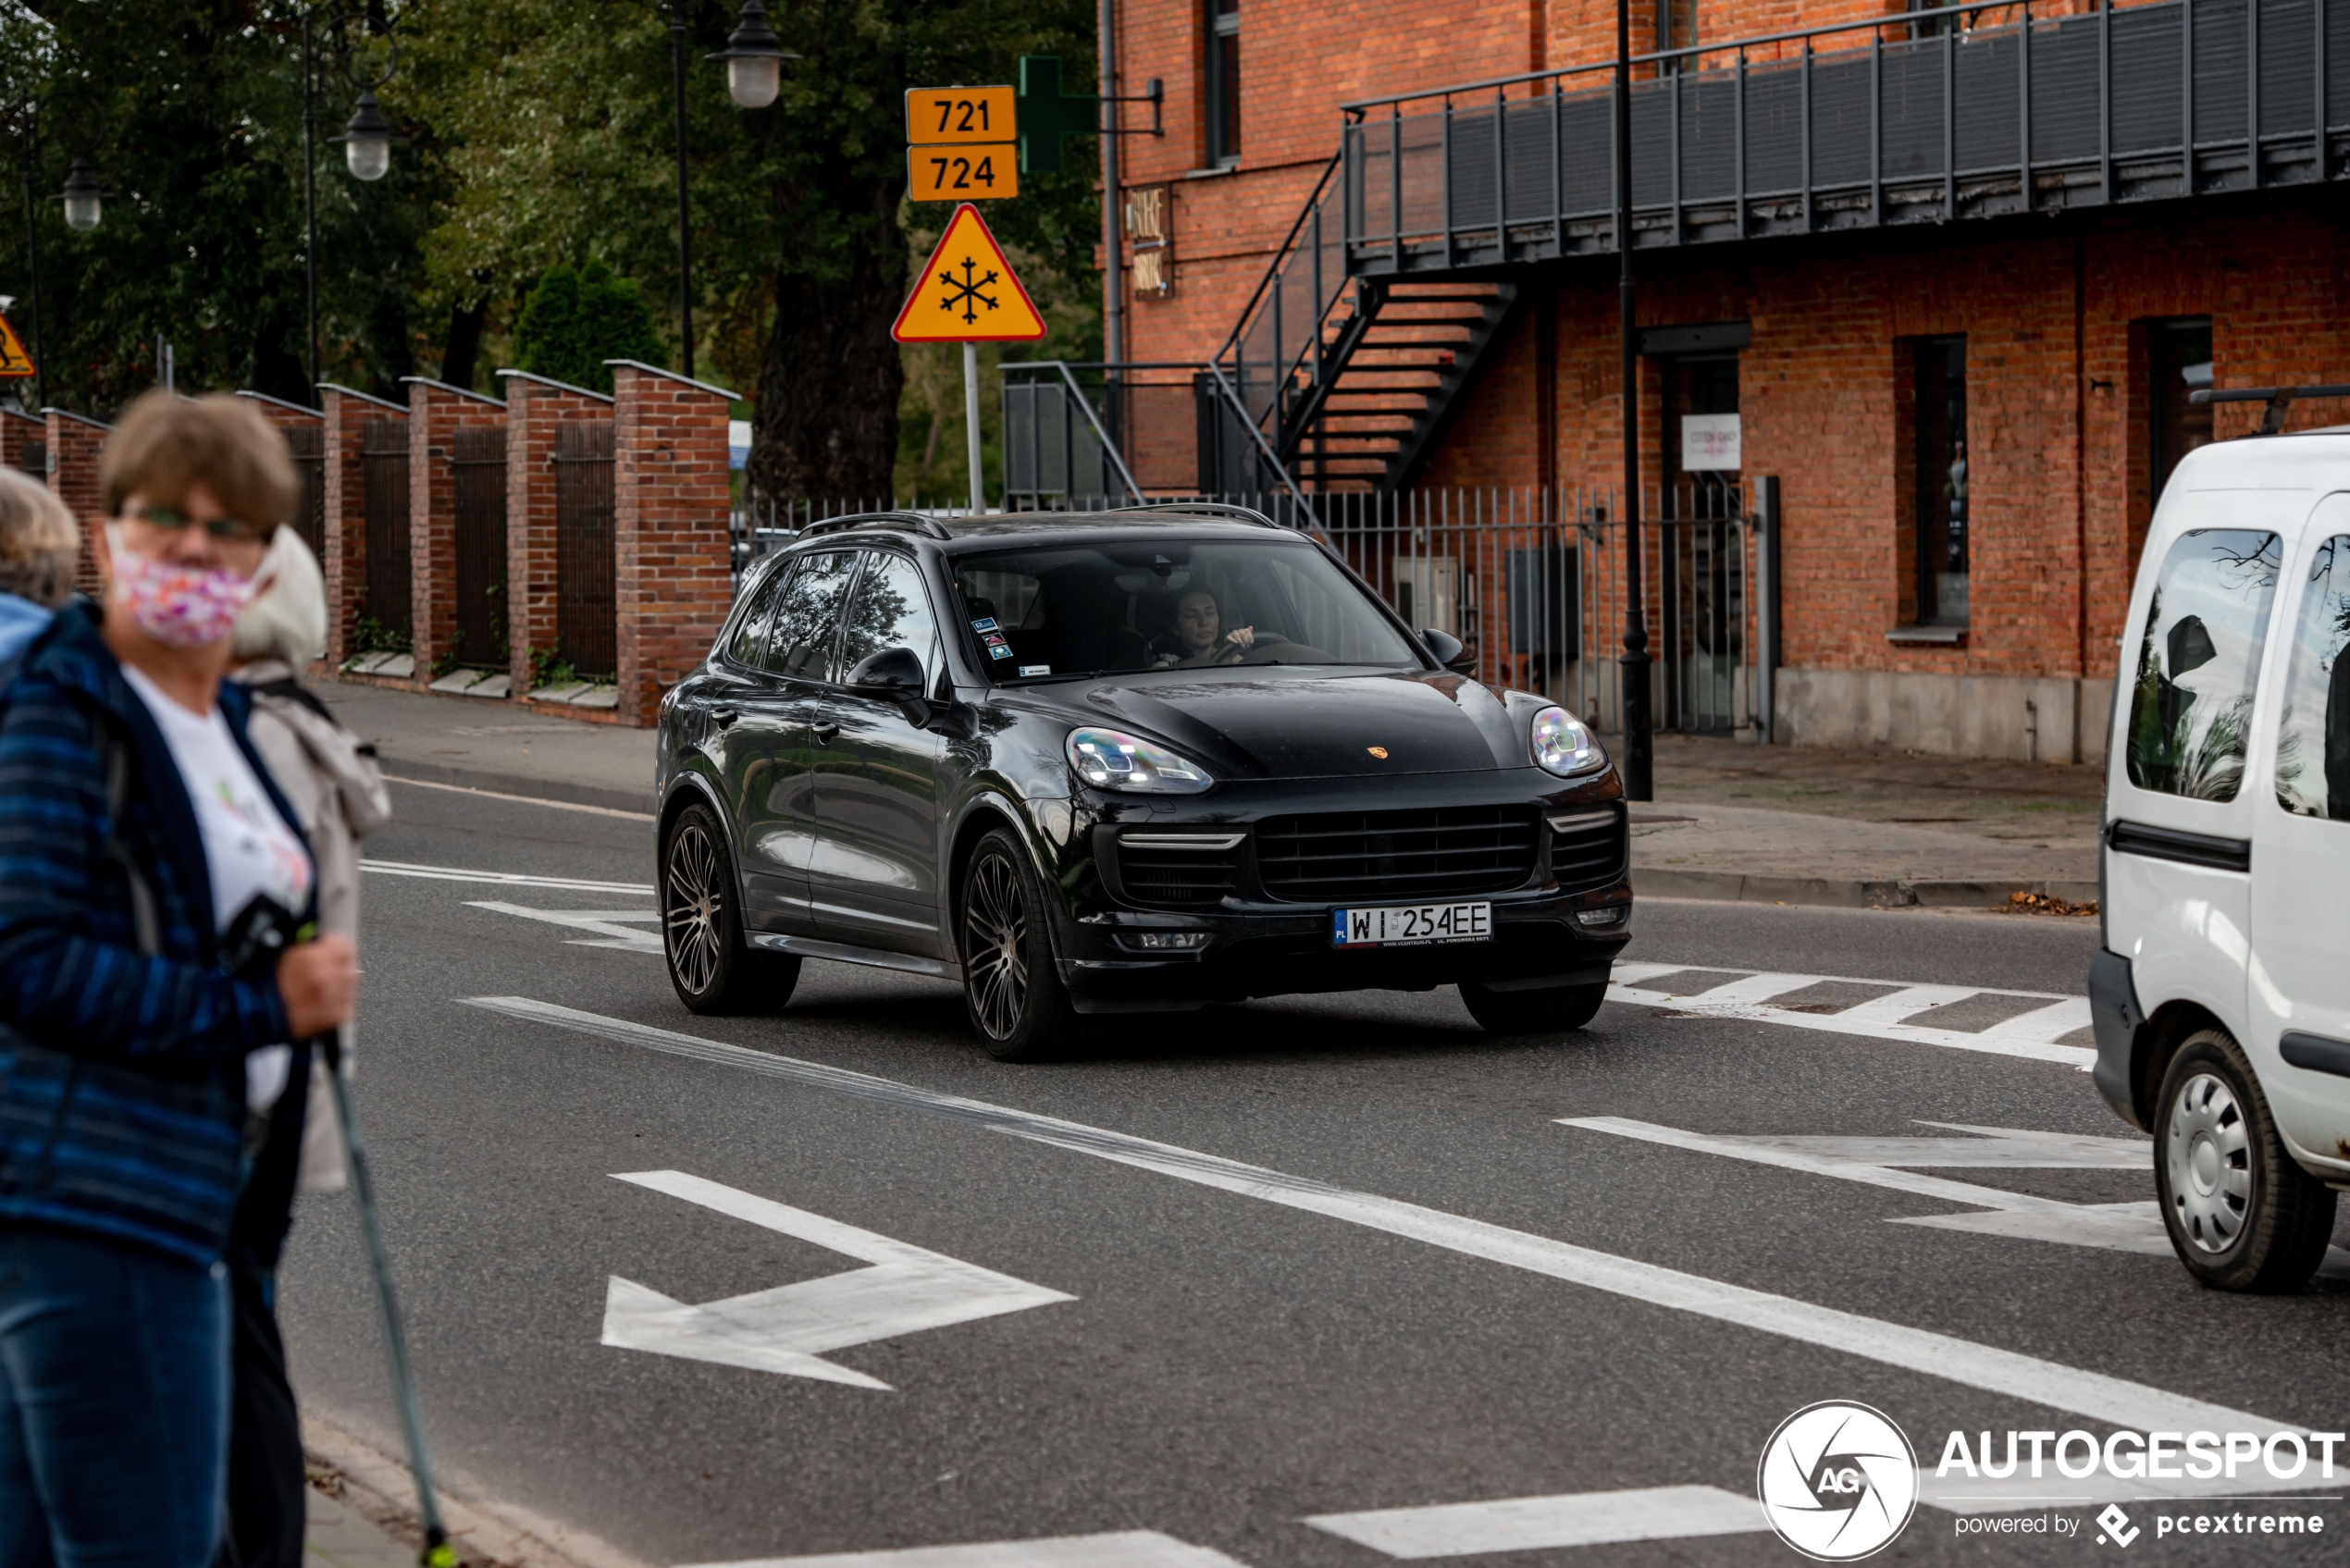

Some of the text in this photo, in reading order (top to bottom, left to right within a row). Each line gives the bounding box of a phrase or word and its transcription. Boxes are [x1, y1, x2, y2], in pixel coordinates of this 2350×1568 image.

[934, 99, 989, 132] 721
[930, 155, 996, 190] 724
[1336, 930, 1346, 939] PL
[1352, 905, 1487, 940] WI 254EE
